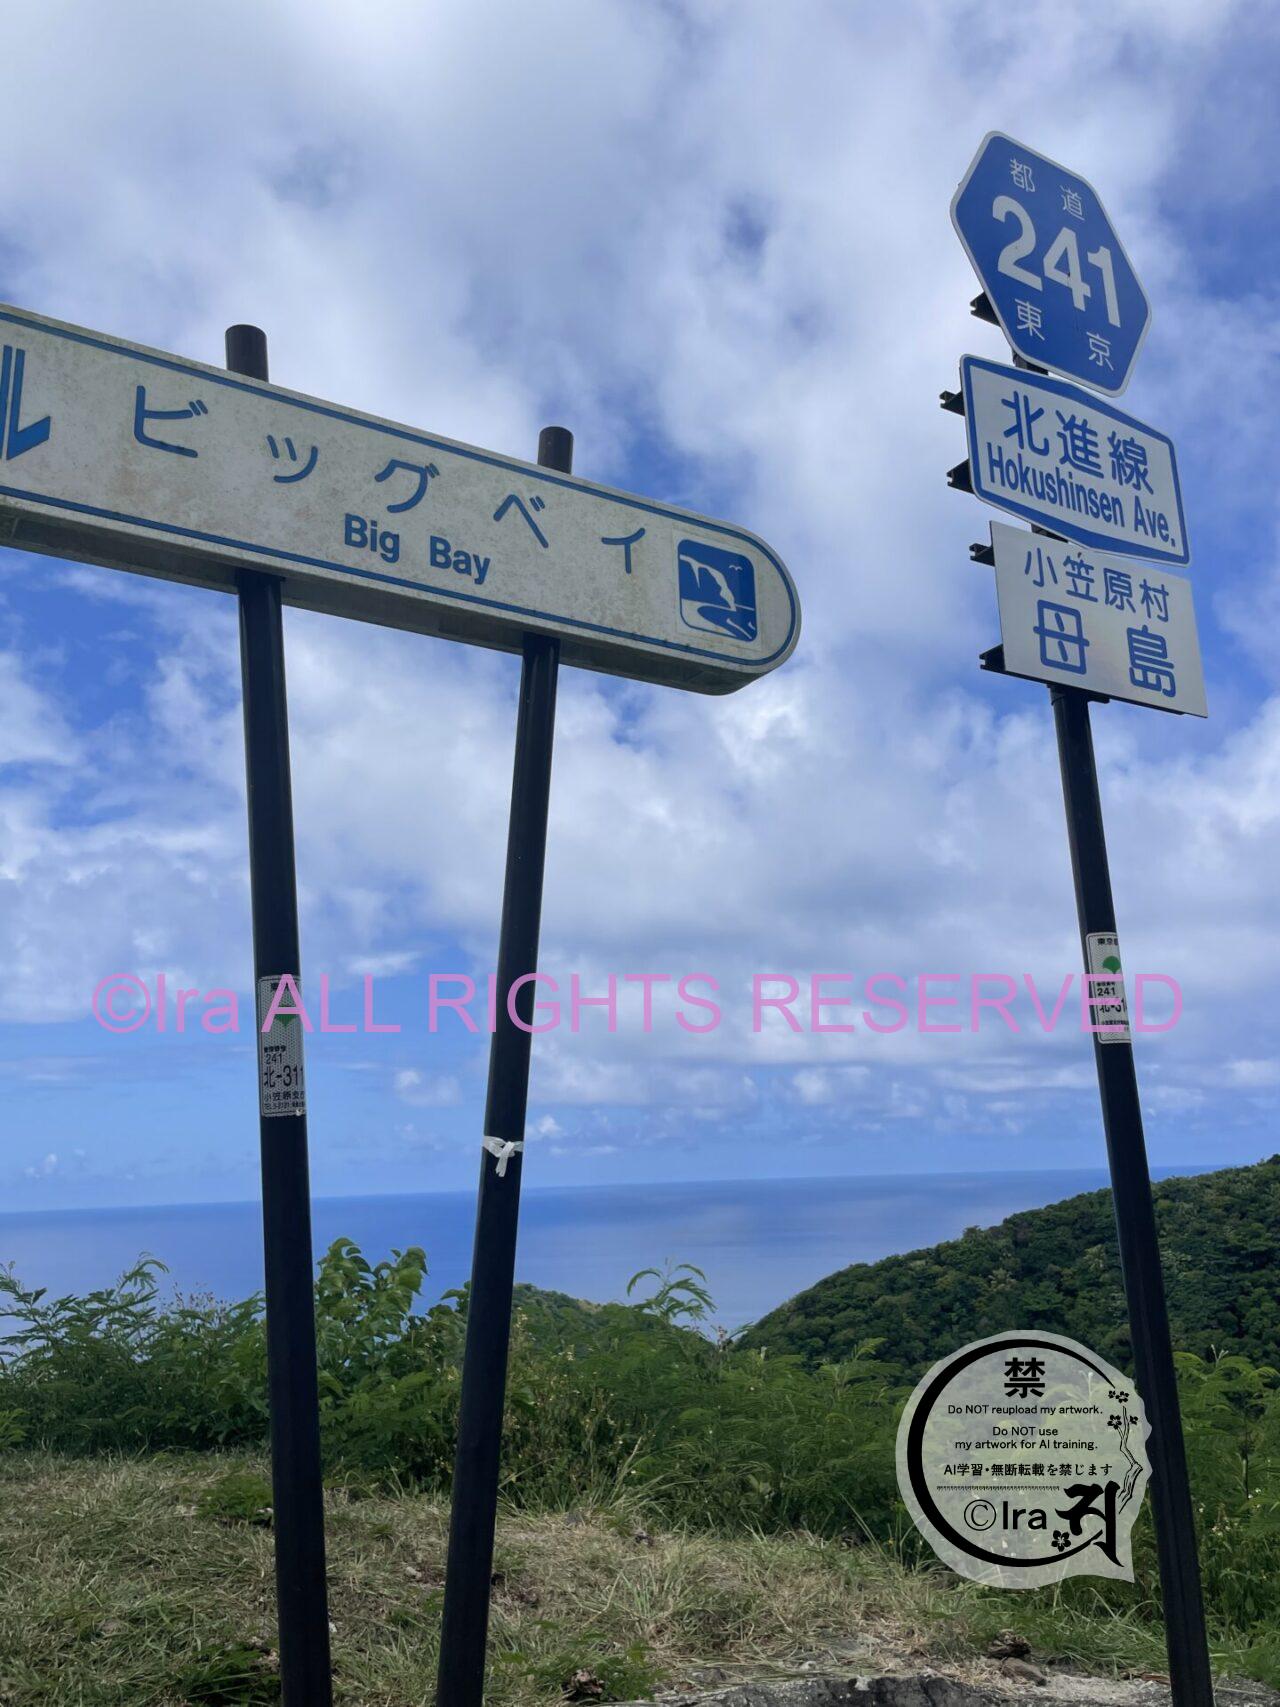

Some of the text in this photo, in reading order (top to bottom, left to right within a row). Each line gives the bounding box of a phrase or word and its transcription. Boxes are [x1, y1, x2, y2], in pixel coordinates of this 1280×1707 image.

[1008, 158, 1086, 221] 都道
[992, 195, 1121, 328] 241
[1014, 298, 1114, 371] 東京
[1001, 390, 1154, 495] 北進線
[987, 441, 1176, 547] Hokushinsen Ave.
[344, 513, 491, 585] Big Bay
[1024, 547, 1169, 622] 小笠原村
[1033, 599, 1176, 698] 母島
[1097, 987, 1116, 997] 241
[265, 1053, 283, 1065] 241
